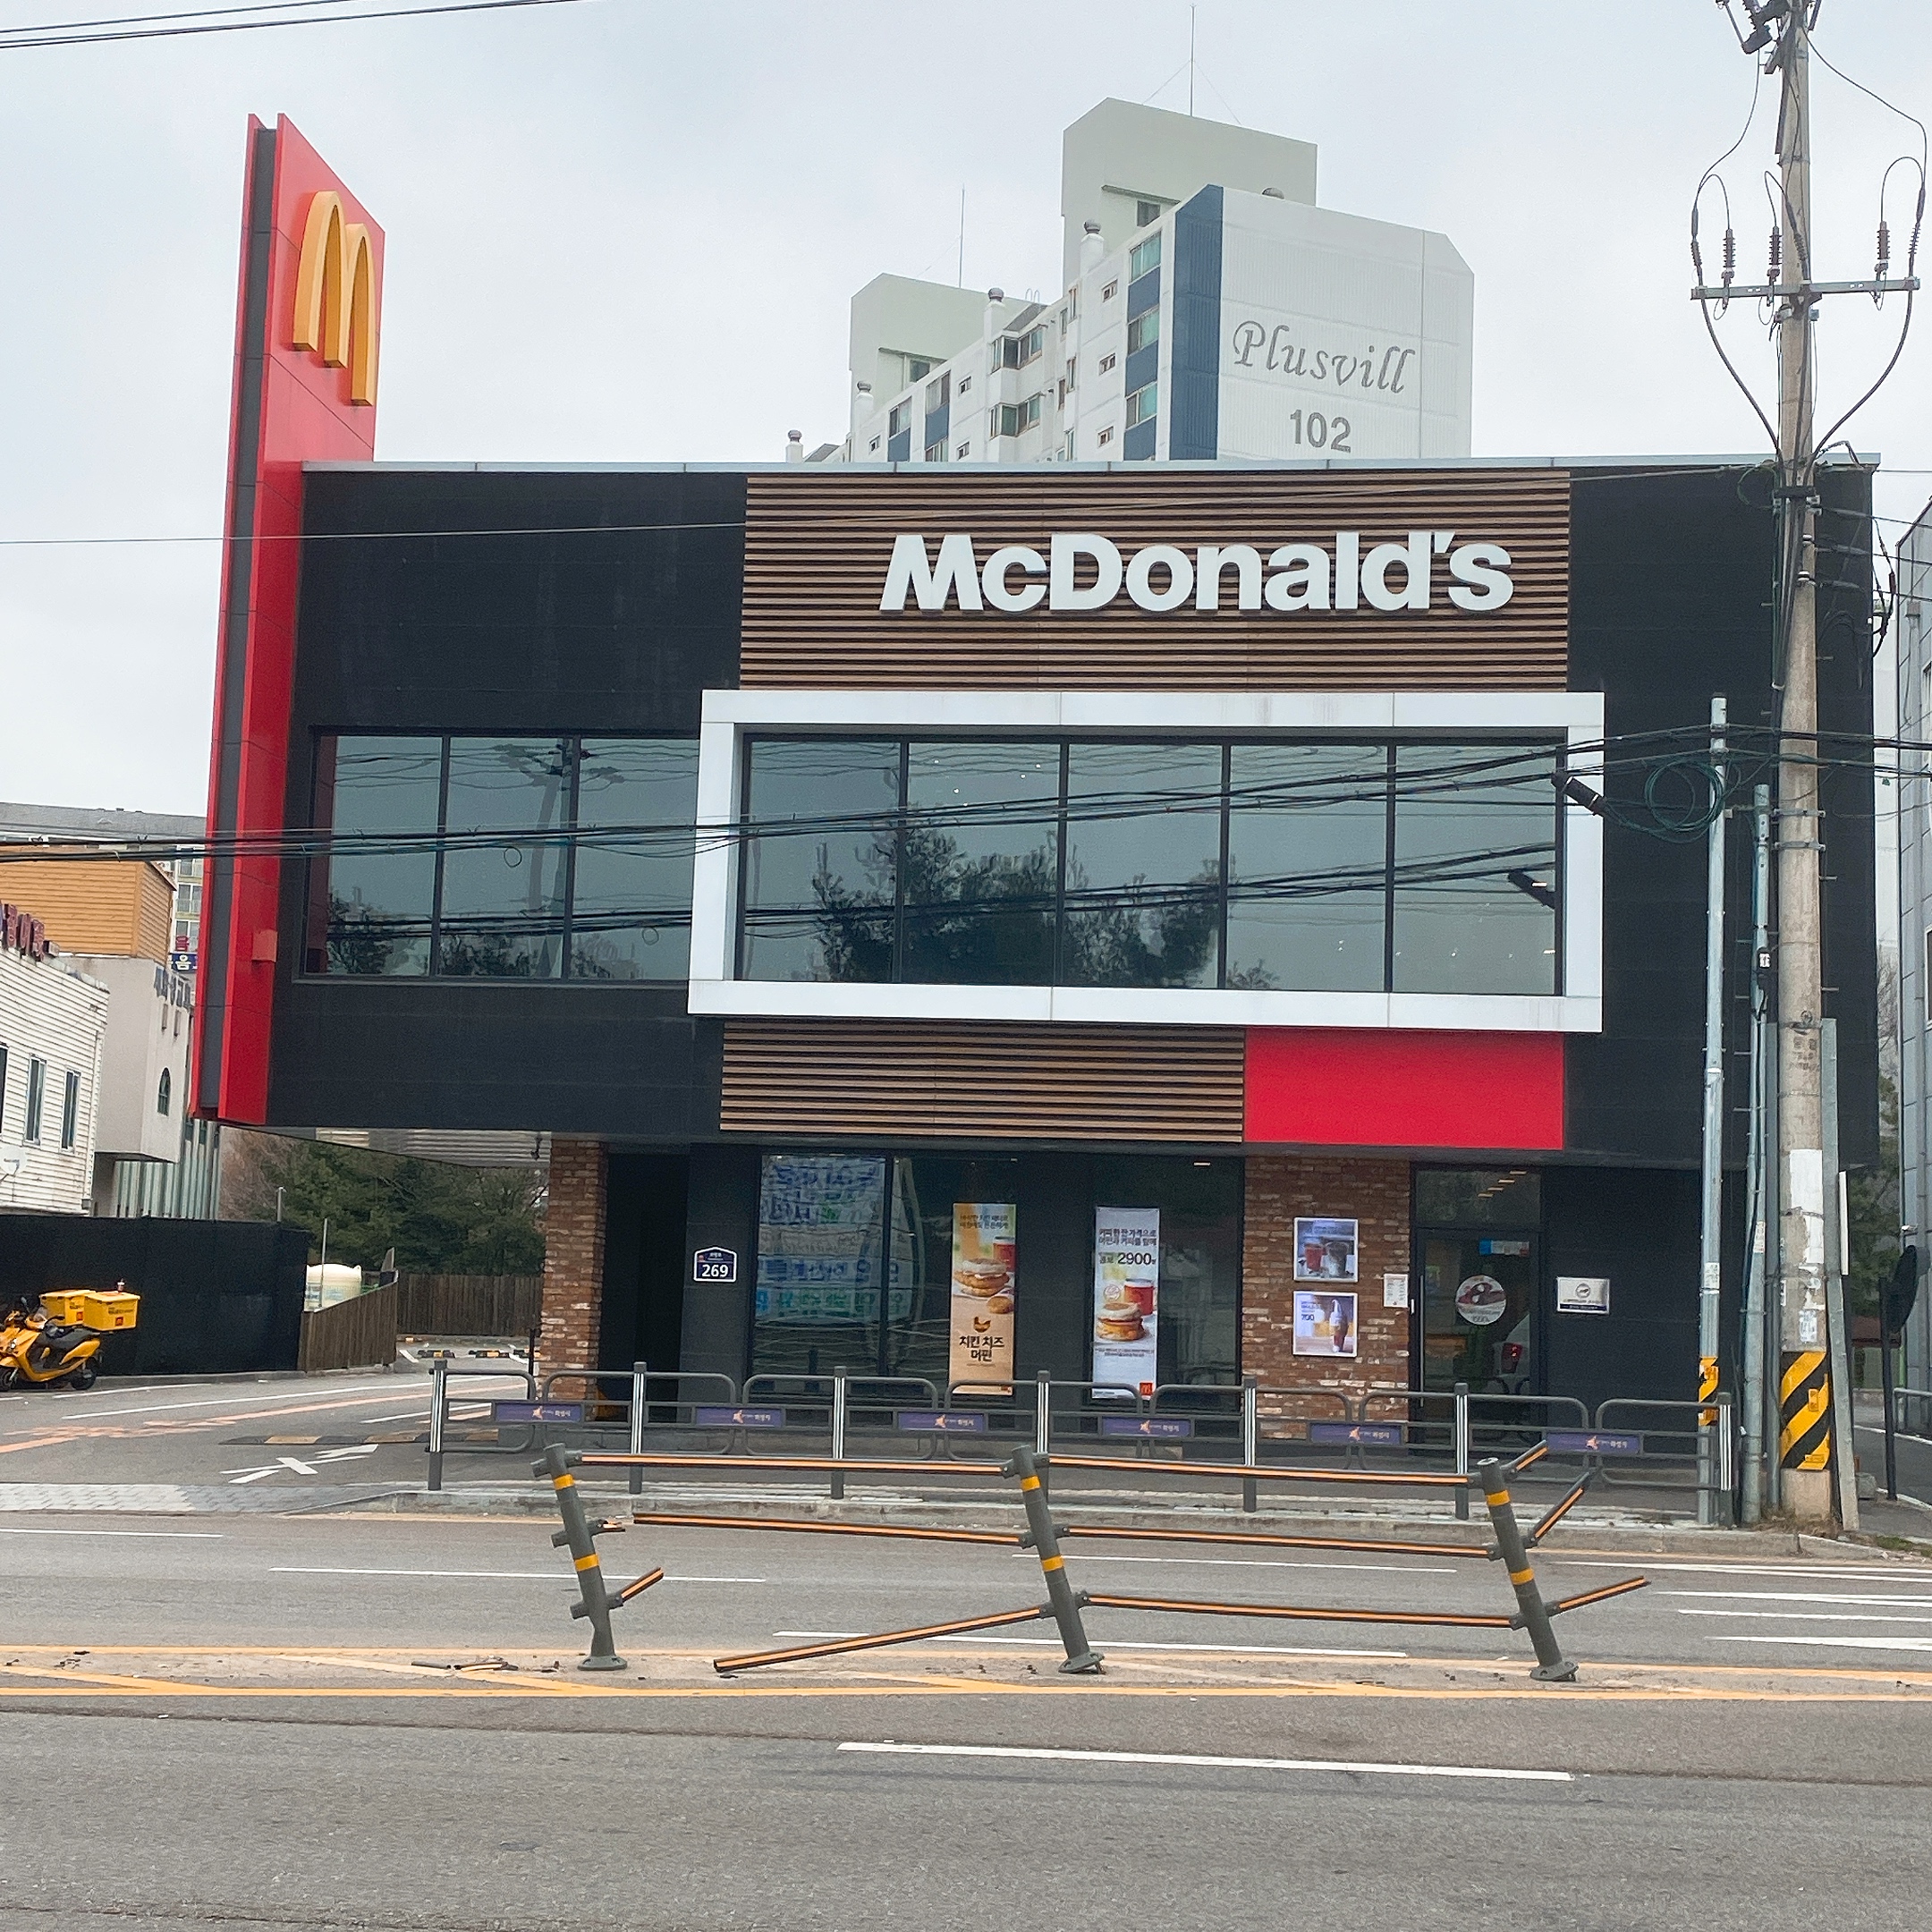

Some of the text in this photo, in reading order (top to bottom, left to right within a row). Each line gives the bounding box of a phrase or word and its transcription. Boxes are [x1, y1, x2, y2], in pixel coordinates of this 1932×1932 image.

[1233, 320, 1416, 394] Plusvill
[1290, 409, 1352, 453] 102
[879, 531, 1514, 613] McDonald's
[701, 1264, 729, 1277] 269
[960, 1335, 1004, 1349] 치킨 치즈
[971, 1349, 992, 1361] 머핀
